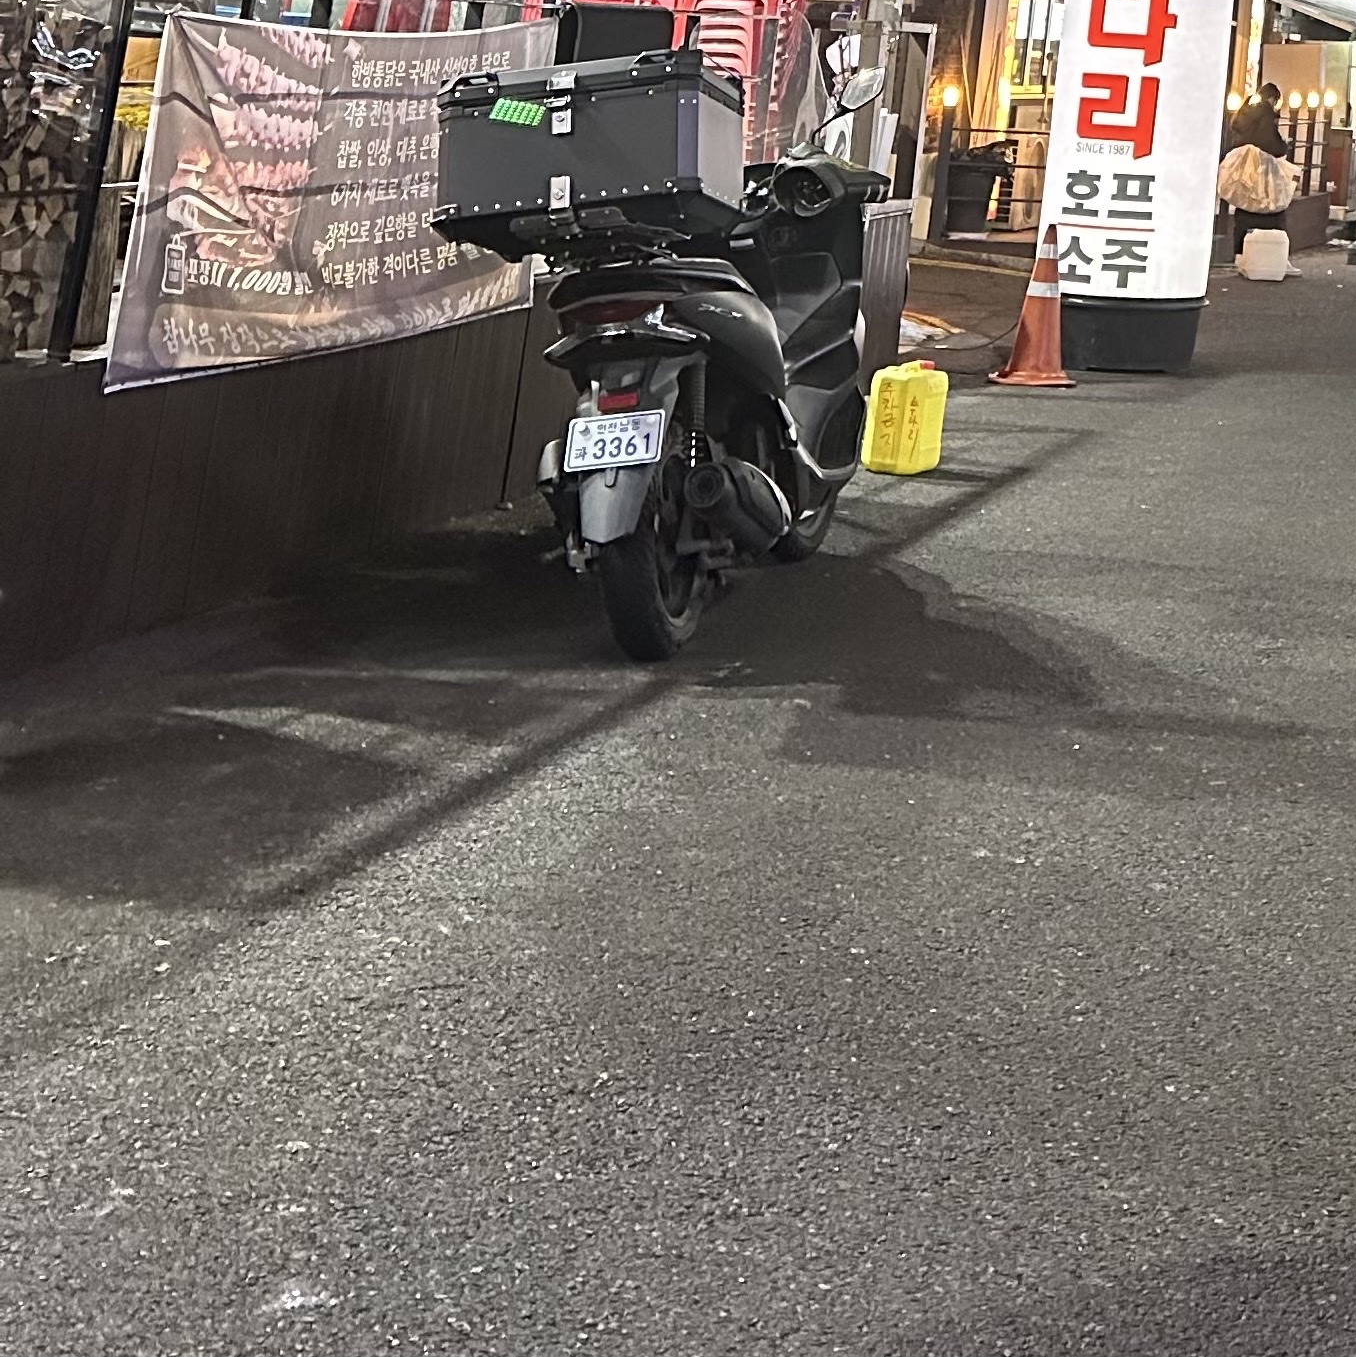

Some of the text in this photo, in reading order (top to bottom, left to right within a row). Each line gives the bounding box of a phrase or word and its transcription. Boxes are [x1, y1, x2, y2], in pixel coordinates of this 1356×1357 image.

[351, 59, 406, 89] 한방통닭은
[408, 57, 441, 85] 국내산
[343, 99, 367, 129] 각종
[1076, 141, 1131, 155] SINCE 1987
[331, 179, 364, 208] 6가지
[1062, 169, 1156, 221] 호프
[325, 220, 370, 253] 장작으로
[321, 256, 380, 290] 비교불가한
[382, 244, 434, 281] 격이다른
[1058, 235, 1149, 289] 소주
[592, 432, 651, 460] 3361
